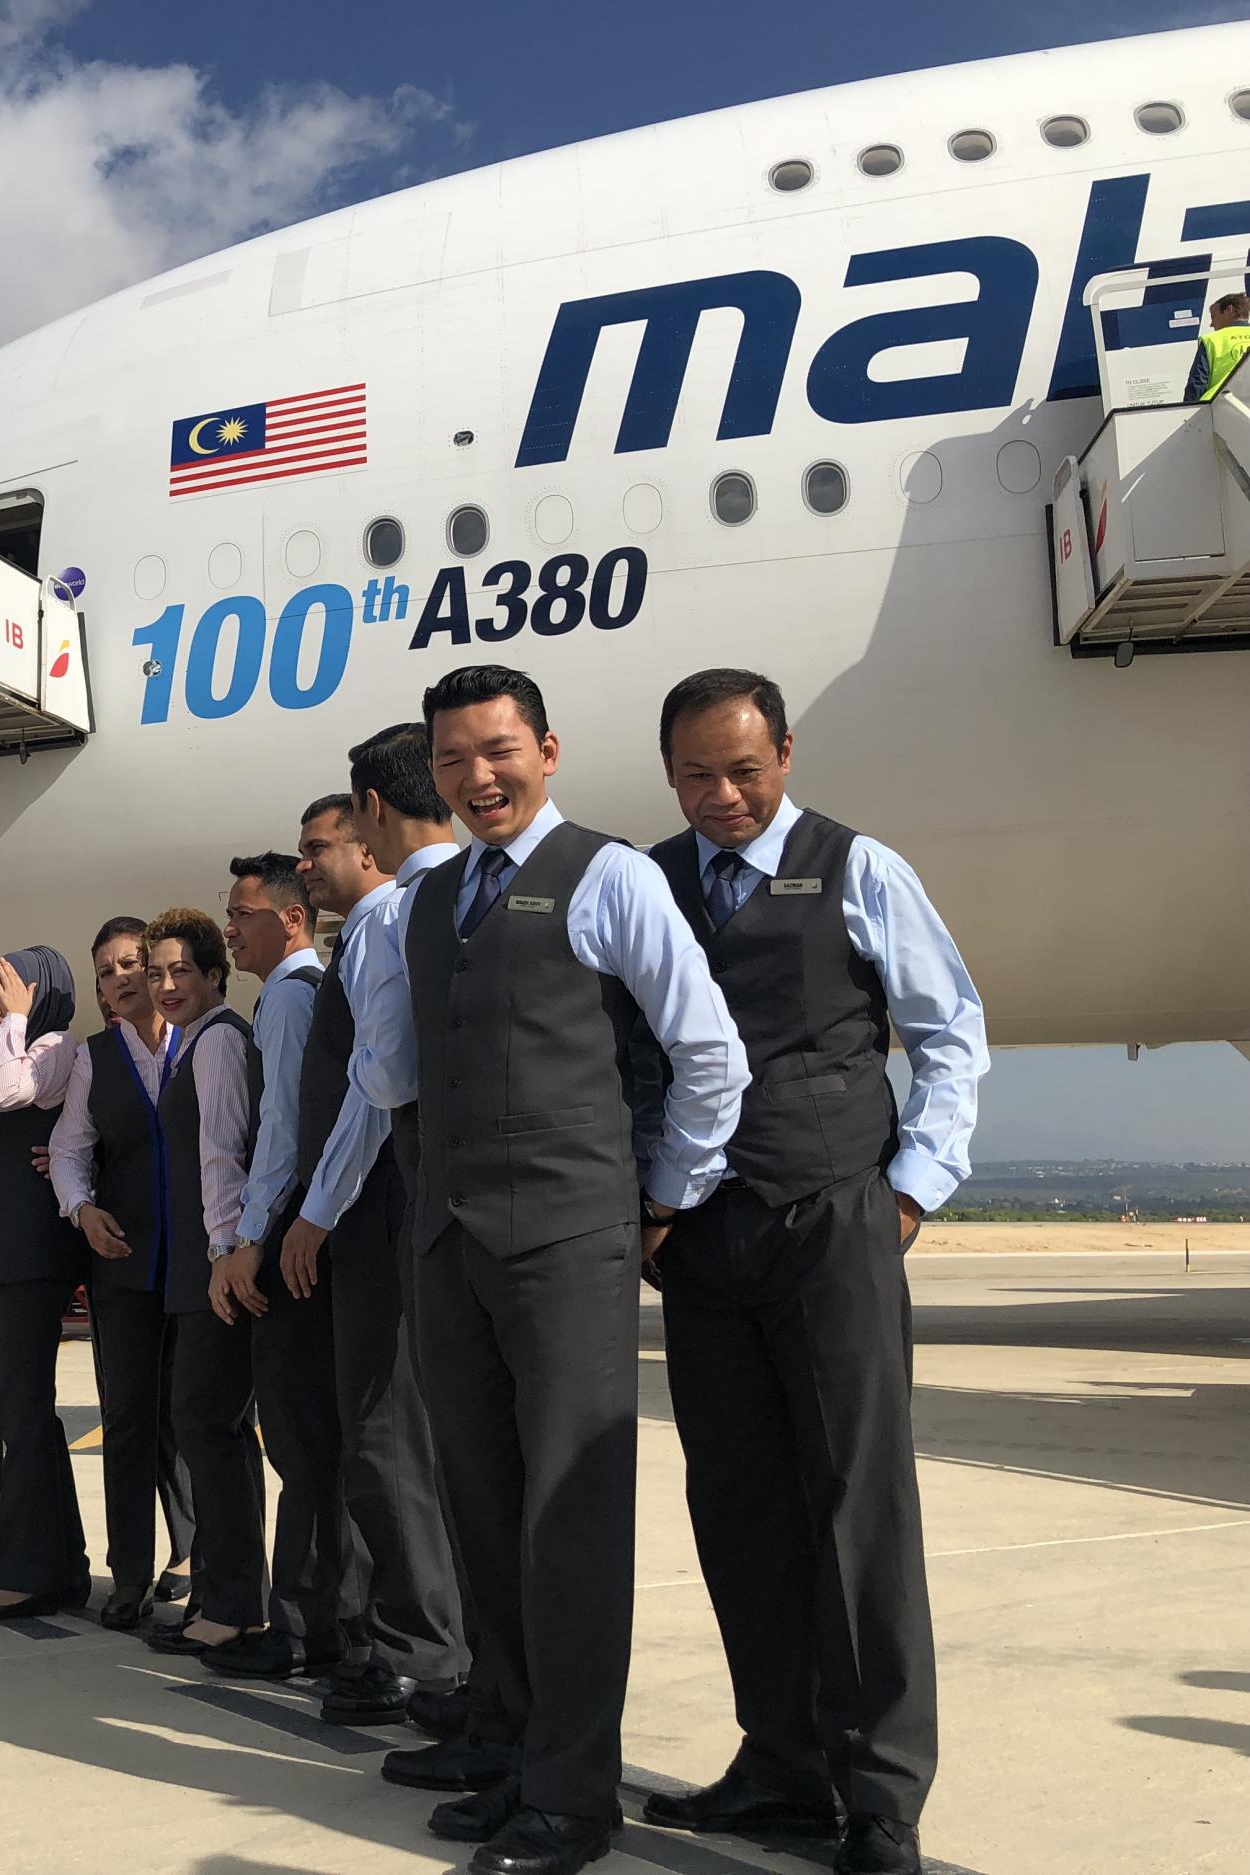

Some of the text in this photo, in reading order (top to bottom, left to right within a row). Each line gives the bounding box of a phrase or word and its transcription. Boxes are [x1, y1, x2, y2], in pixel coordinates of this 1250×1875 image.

[1059, 528, 1072, 565] IB
[408, 546, 648, 650] A380
[5, 618, 24, 650] IB
